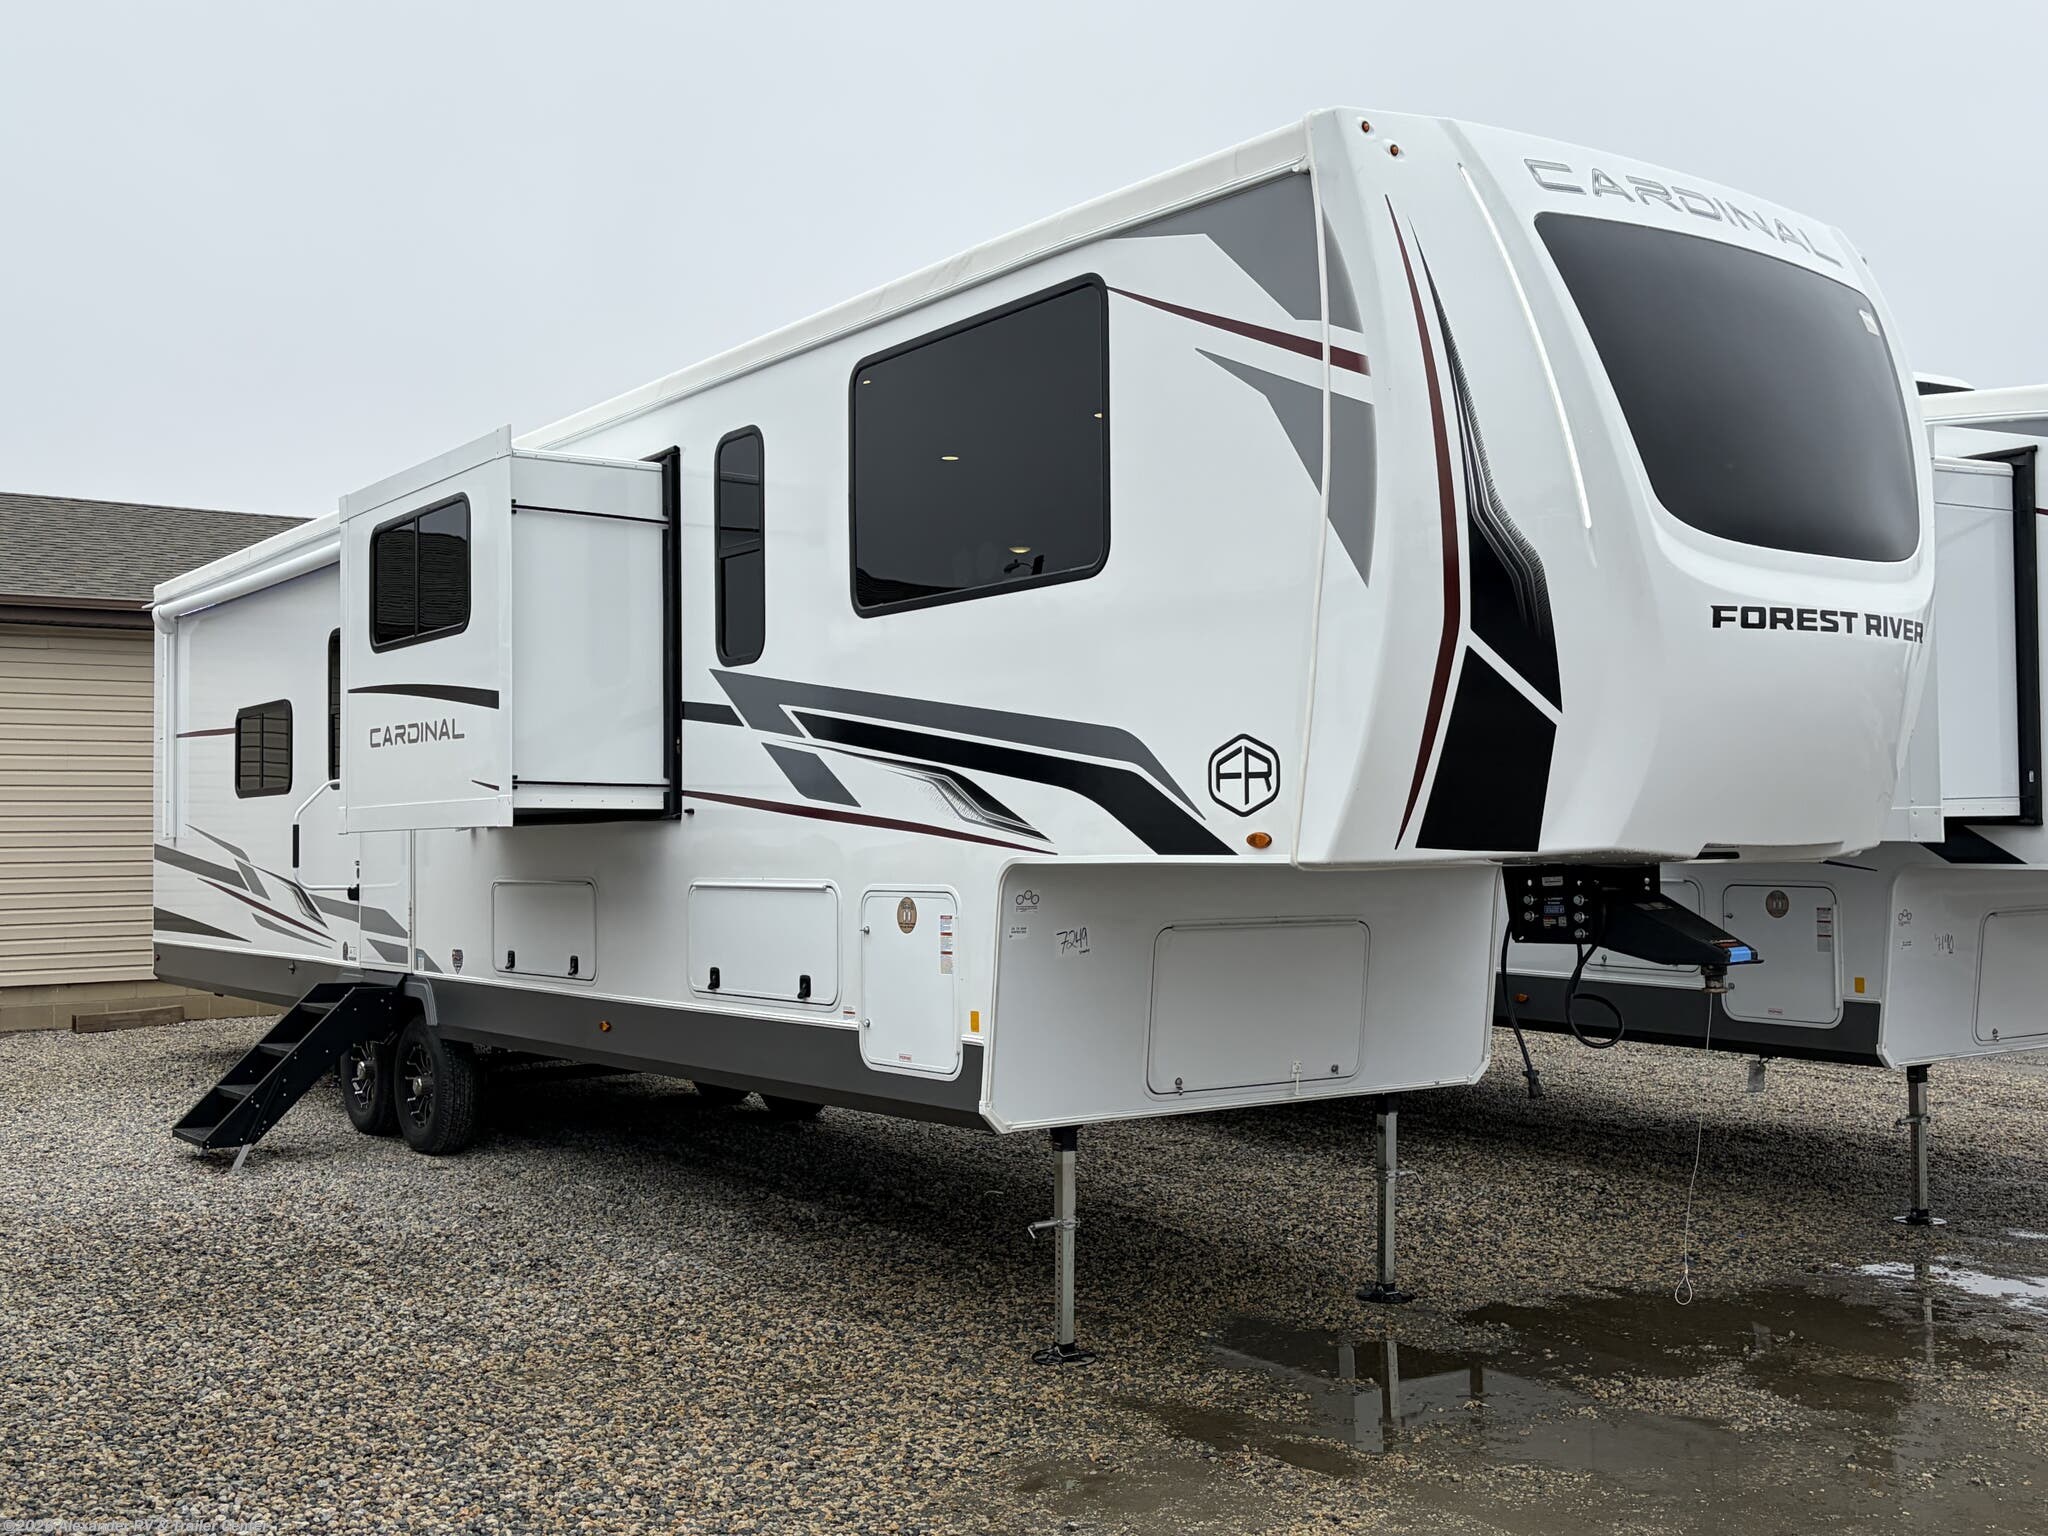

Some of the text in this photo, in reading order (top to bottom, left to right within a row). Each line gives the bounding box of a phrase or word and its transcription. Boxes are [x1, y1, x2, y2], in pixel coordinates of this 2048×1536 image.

[1523, 157, 1843, 268] CARDINAL
[1710, 604, 1924, 644] FOREST RIVER
[369, 717, 466, 748] CARDINAL
[1215, 744, 1273, 806] FR
